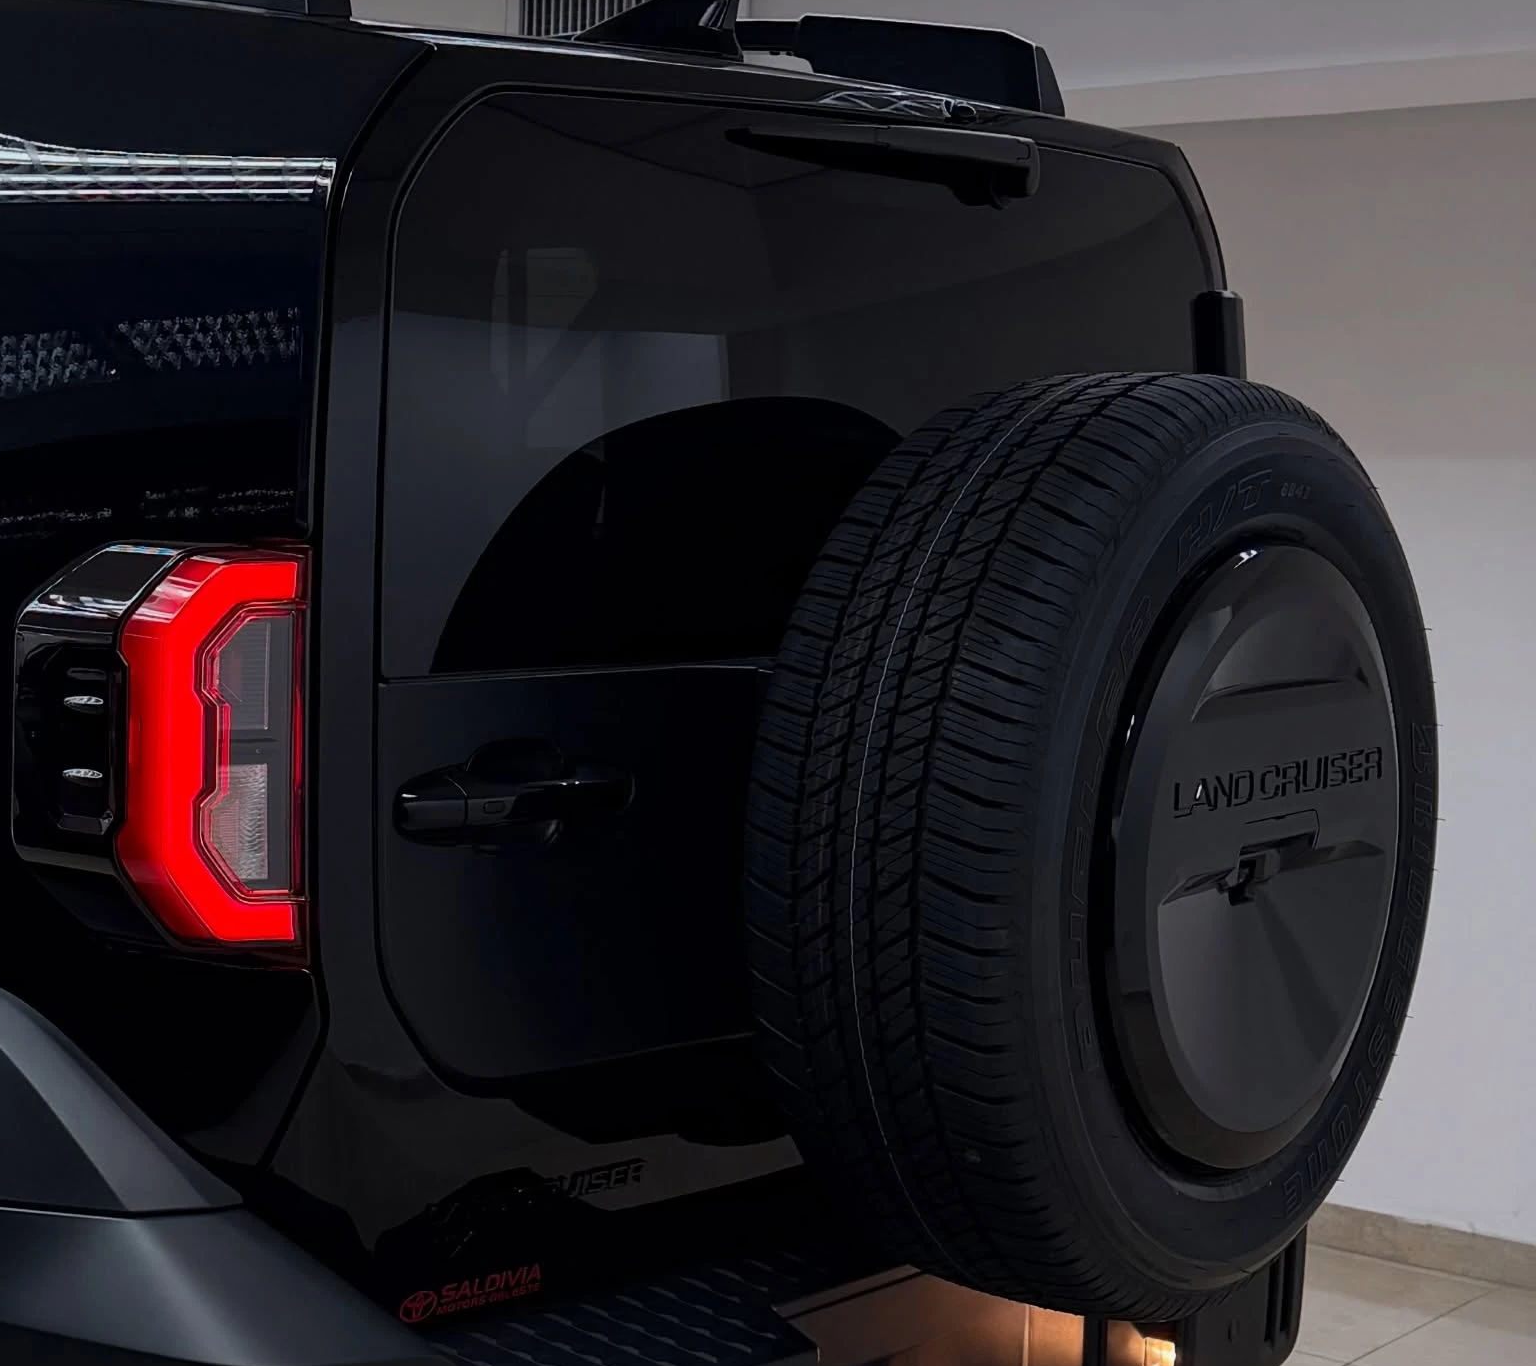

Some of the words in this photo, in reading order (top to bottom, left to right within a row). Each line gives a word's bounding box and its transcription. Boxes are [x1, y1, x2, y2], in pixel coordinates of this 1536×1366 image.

[1172, 769, 1255, 819] LAND
[1259, 746, 1384, 801] CRUISER
[440, 1261, 542, 1304] SALDIVIA
